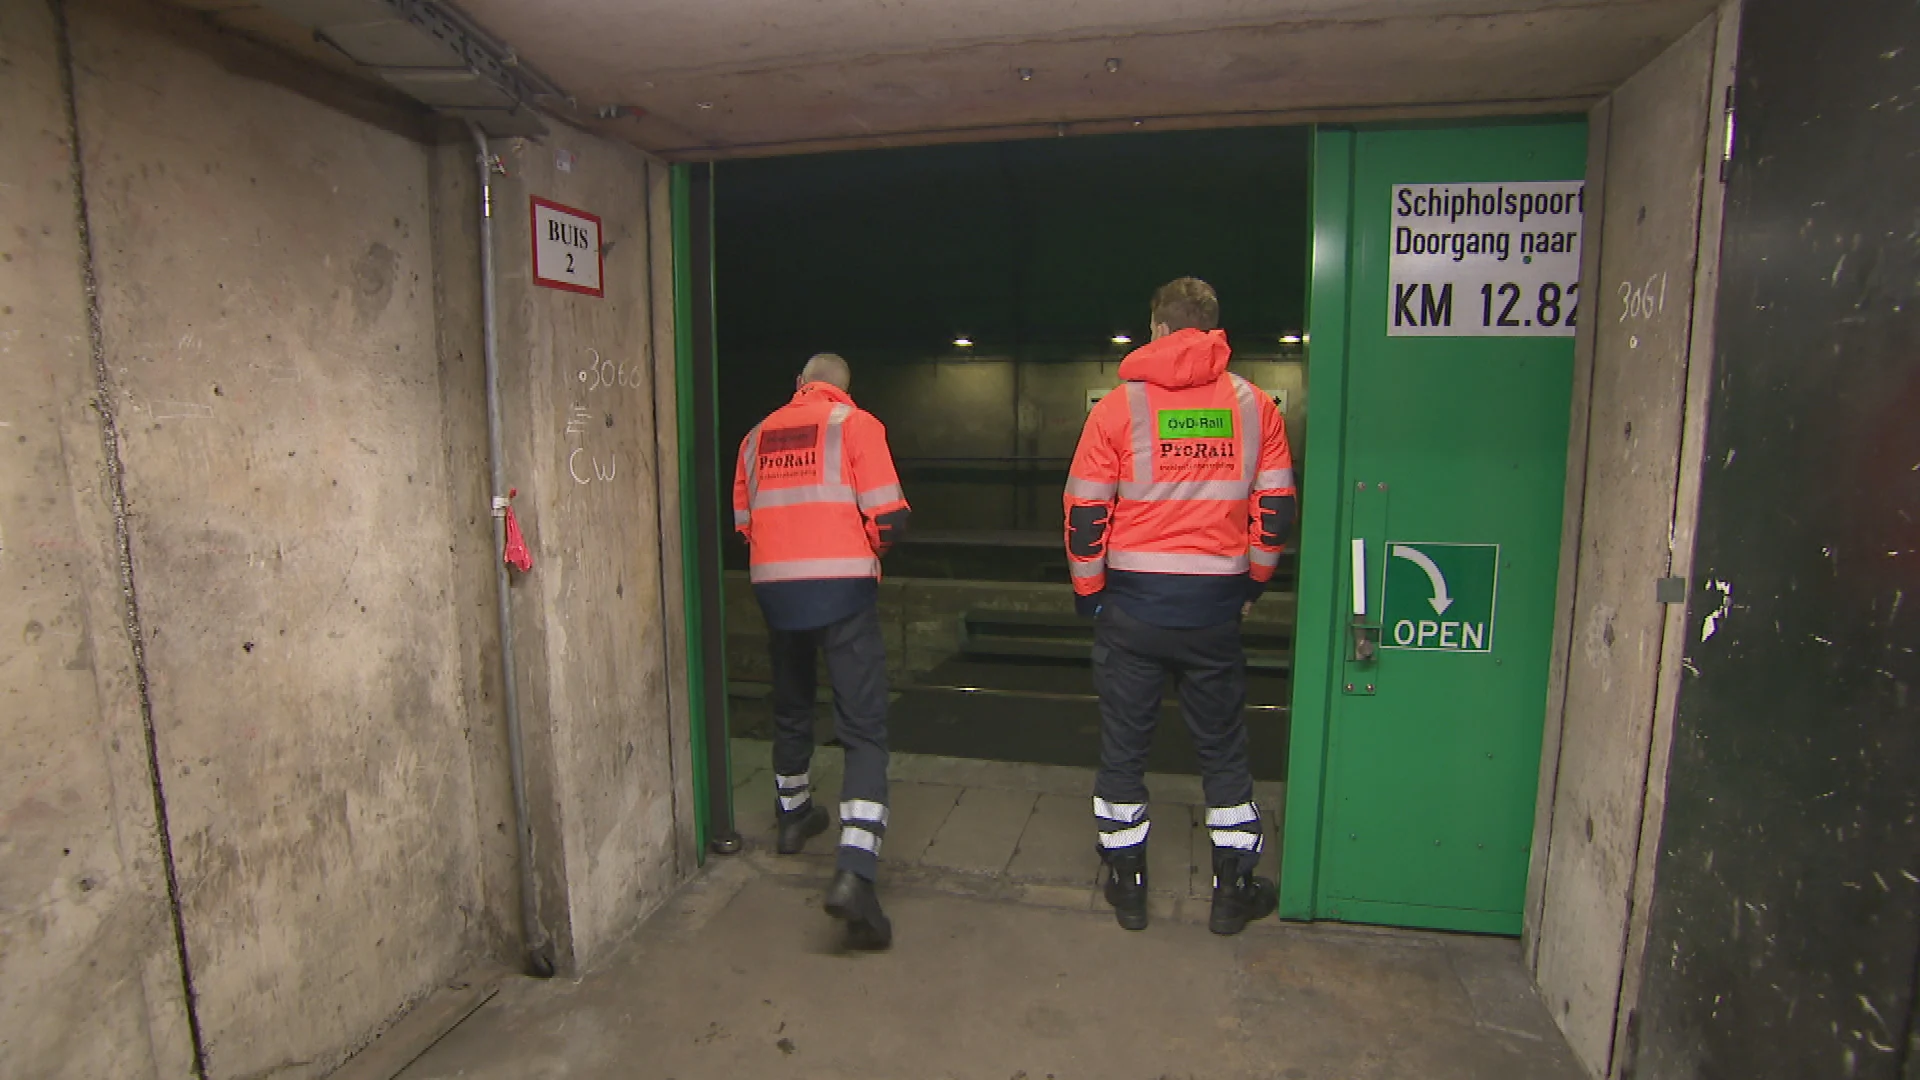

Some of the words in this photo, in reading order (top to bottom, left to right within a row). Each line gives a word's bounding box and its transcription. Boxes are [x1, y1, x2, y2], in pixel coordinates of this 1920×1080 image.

[1397, 186, 1584, 224] Schipholspoort
[548, 219, 588, 250] BUIS
[1396, 226, 1510, 262] Doorgang
[1520, 231, 1577, 254] naar
[565, 252, 575, 274] 2
[1394, 283, 1452, 327] KM
[1616, 271, 1667, 323] 3061
[759, 451, 816, 470] ProRail
[1160, 442, 1234, 458] ProRail
[1393, 619, 1484, 649] OPEN
